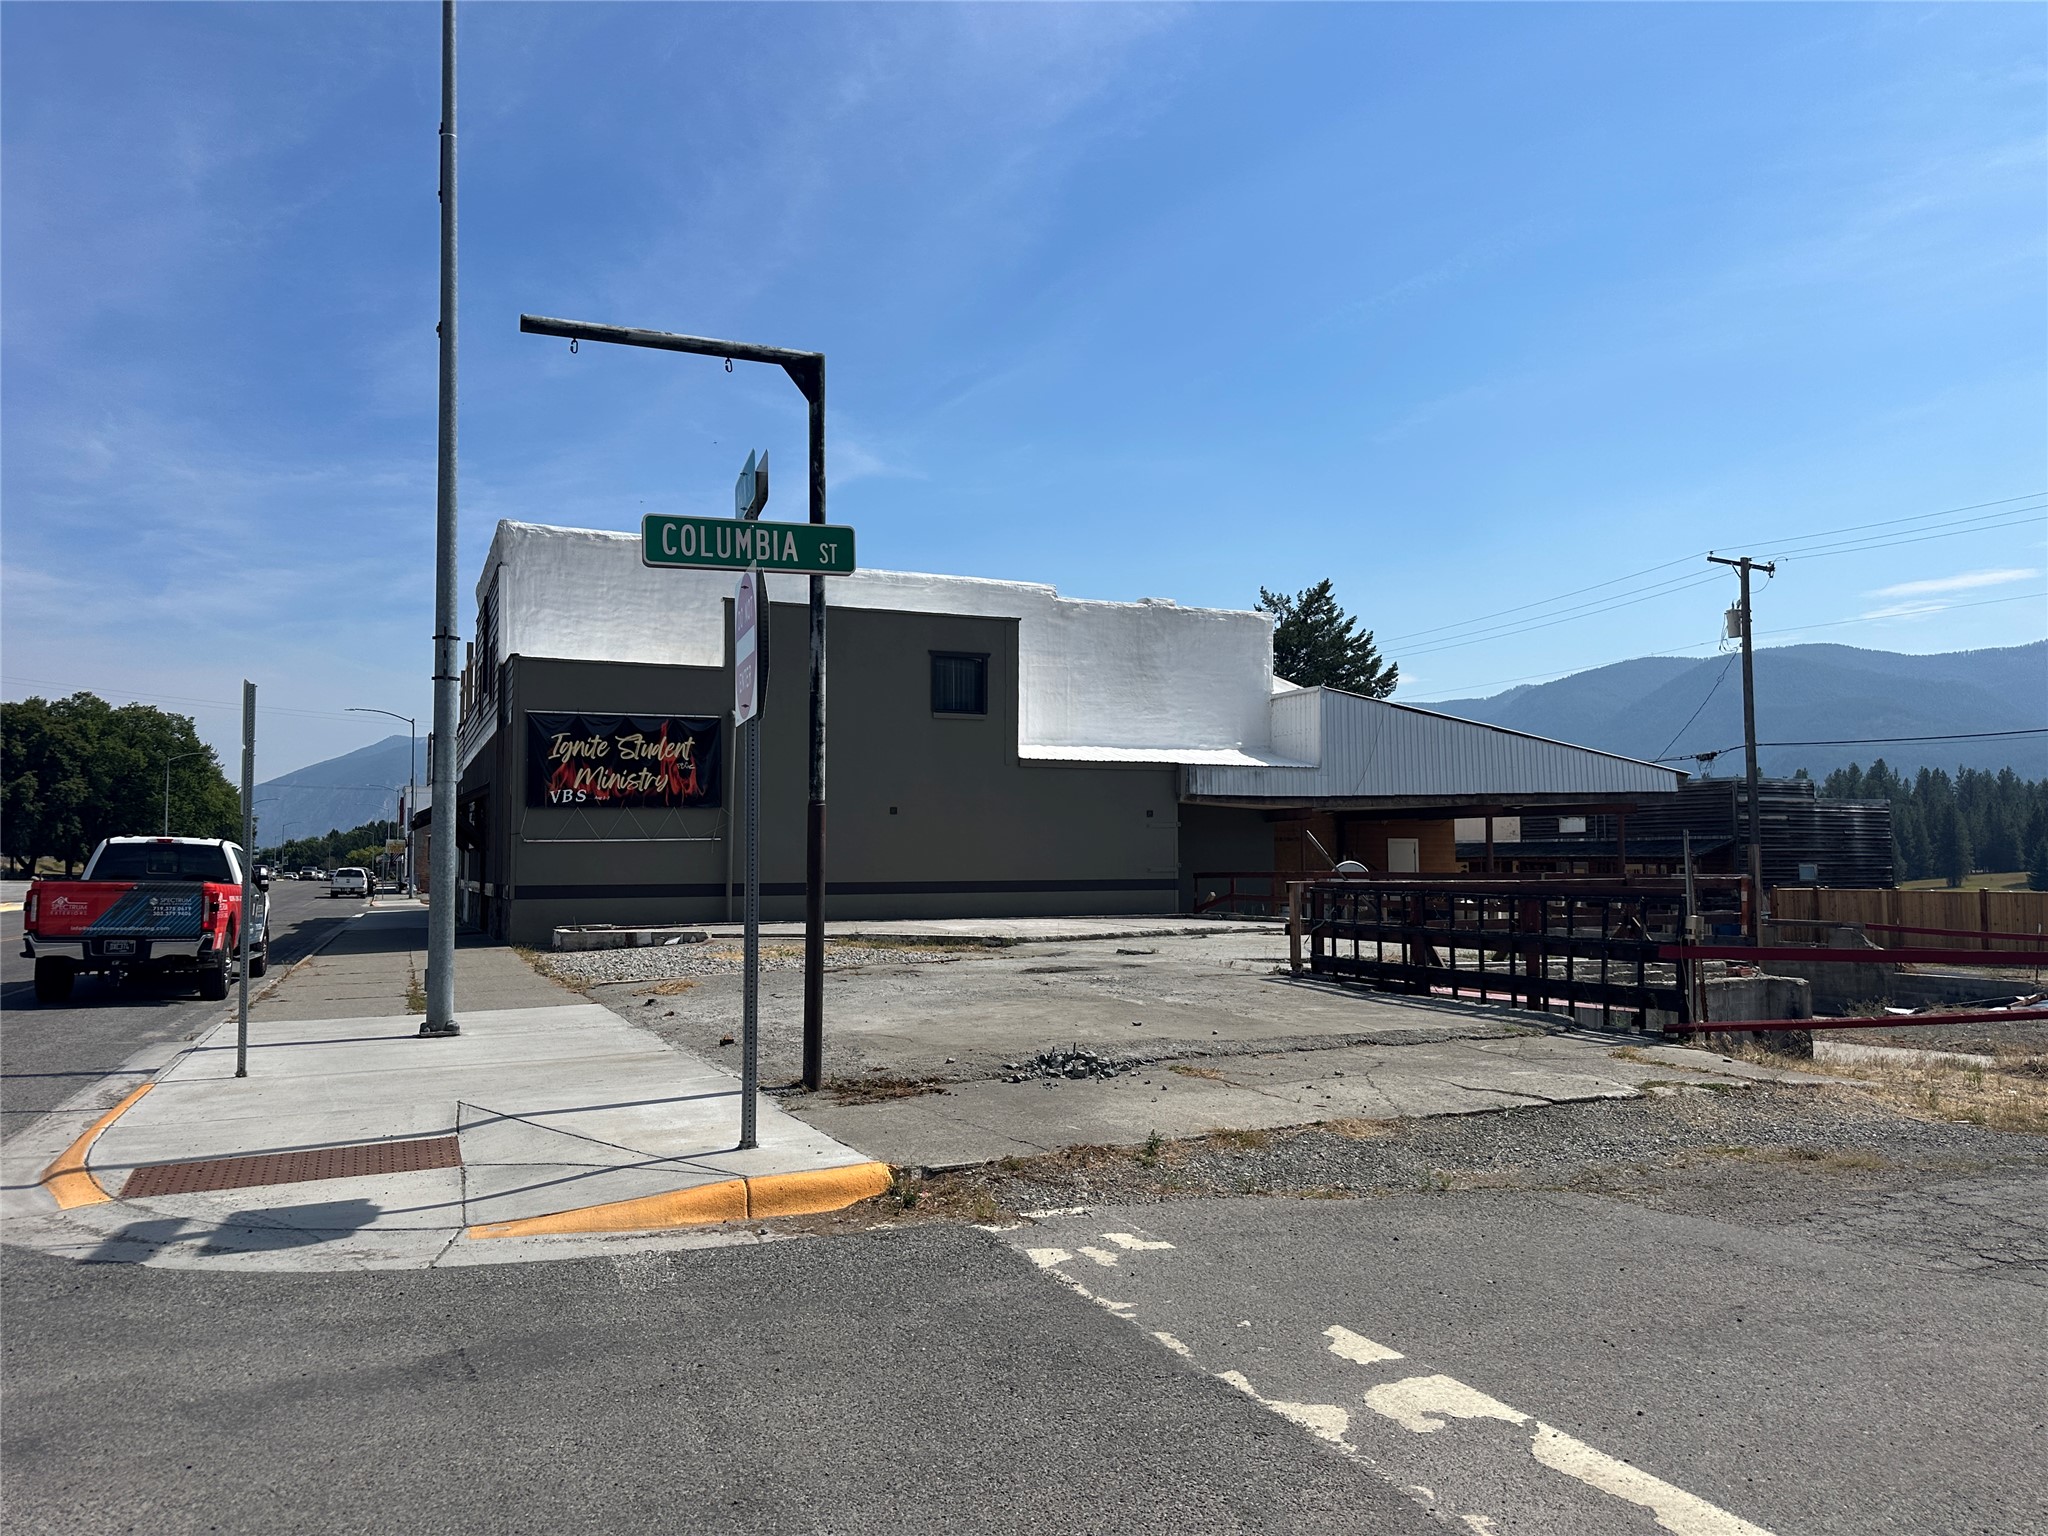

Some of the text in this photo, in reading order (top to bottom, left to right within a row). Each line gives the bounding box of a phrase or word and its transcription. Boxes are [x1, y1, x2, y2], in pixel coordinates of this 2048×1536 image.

[662, 522, 838, 565] COLUMBIA ST
[548, 732, 696, 764] Ignite Student
[573, 765, 671, 794] Ministry
[549, 788, 587, 804] VBS
